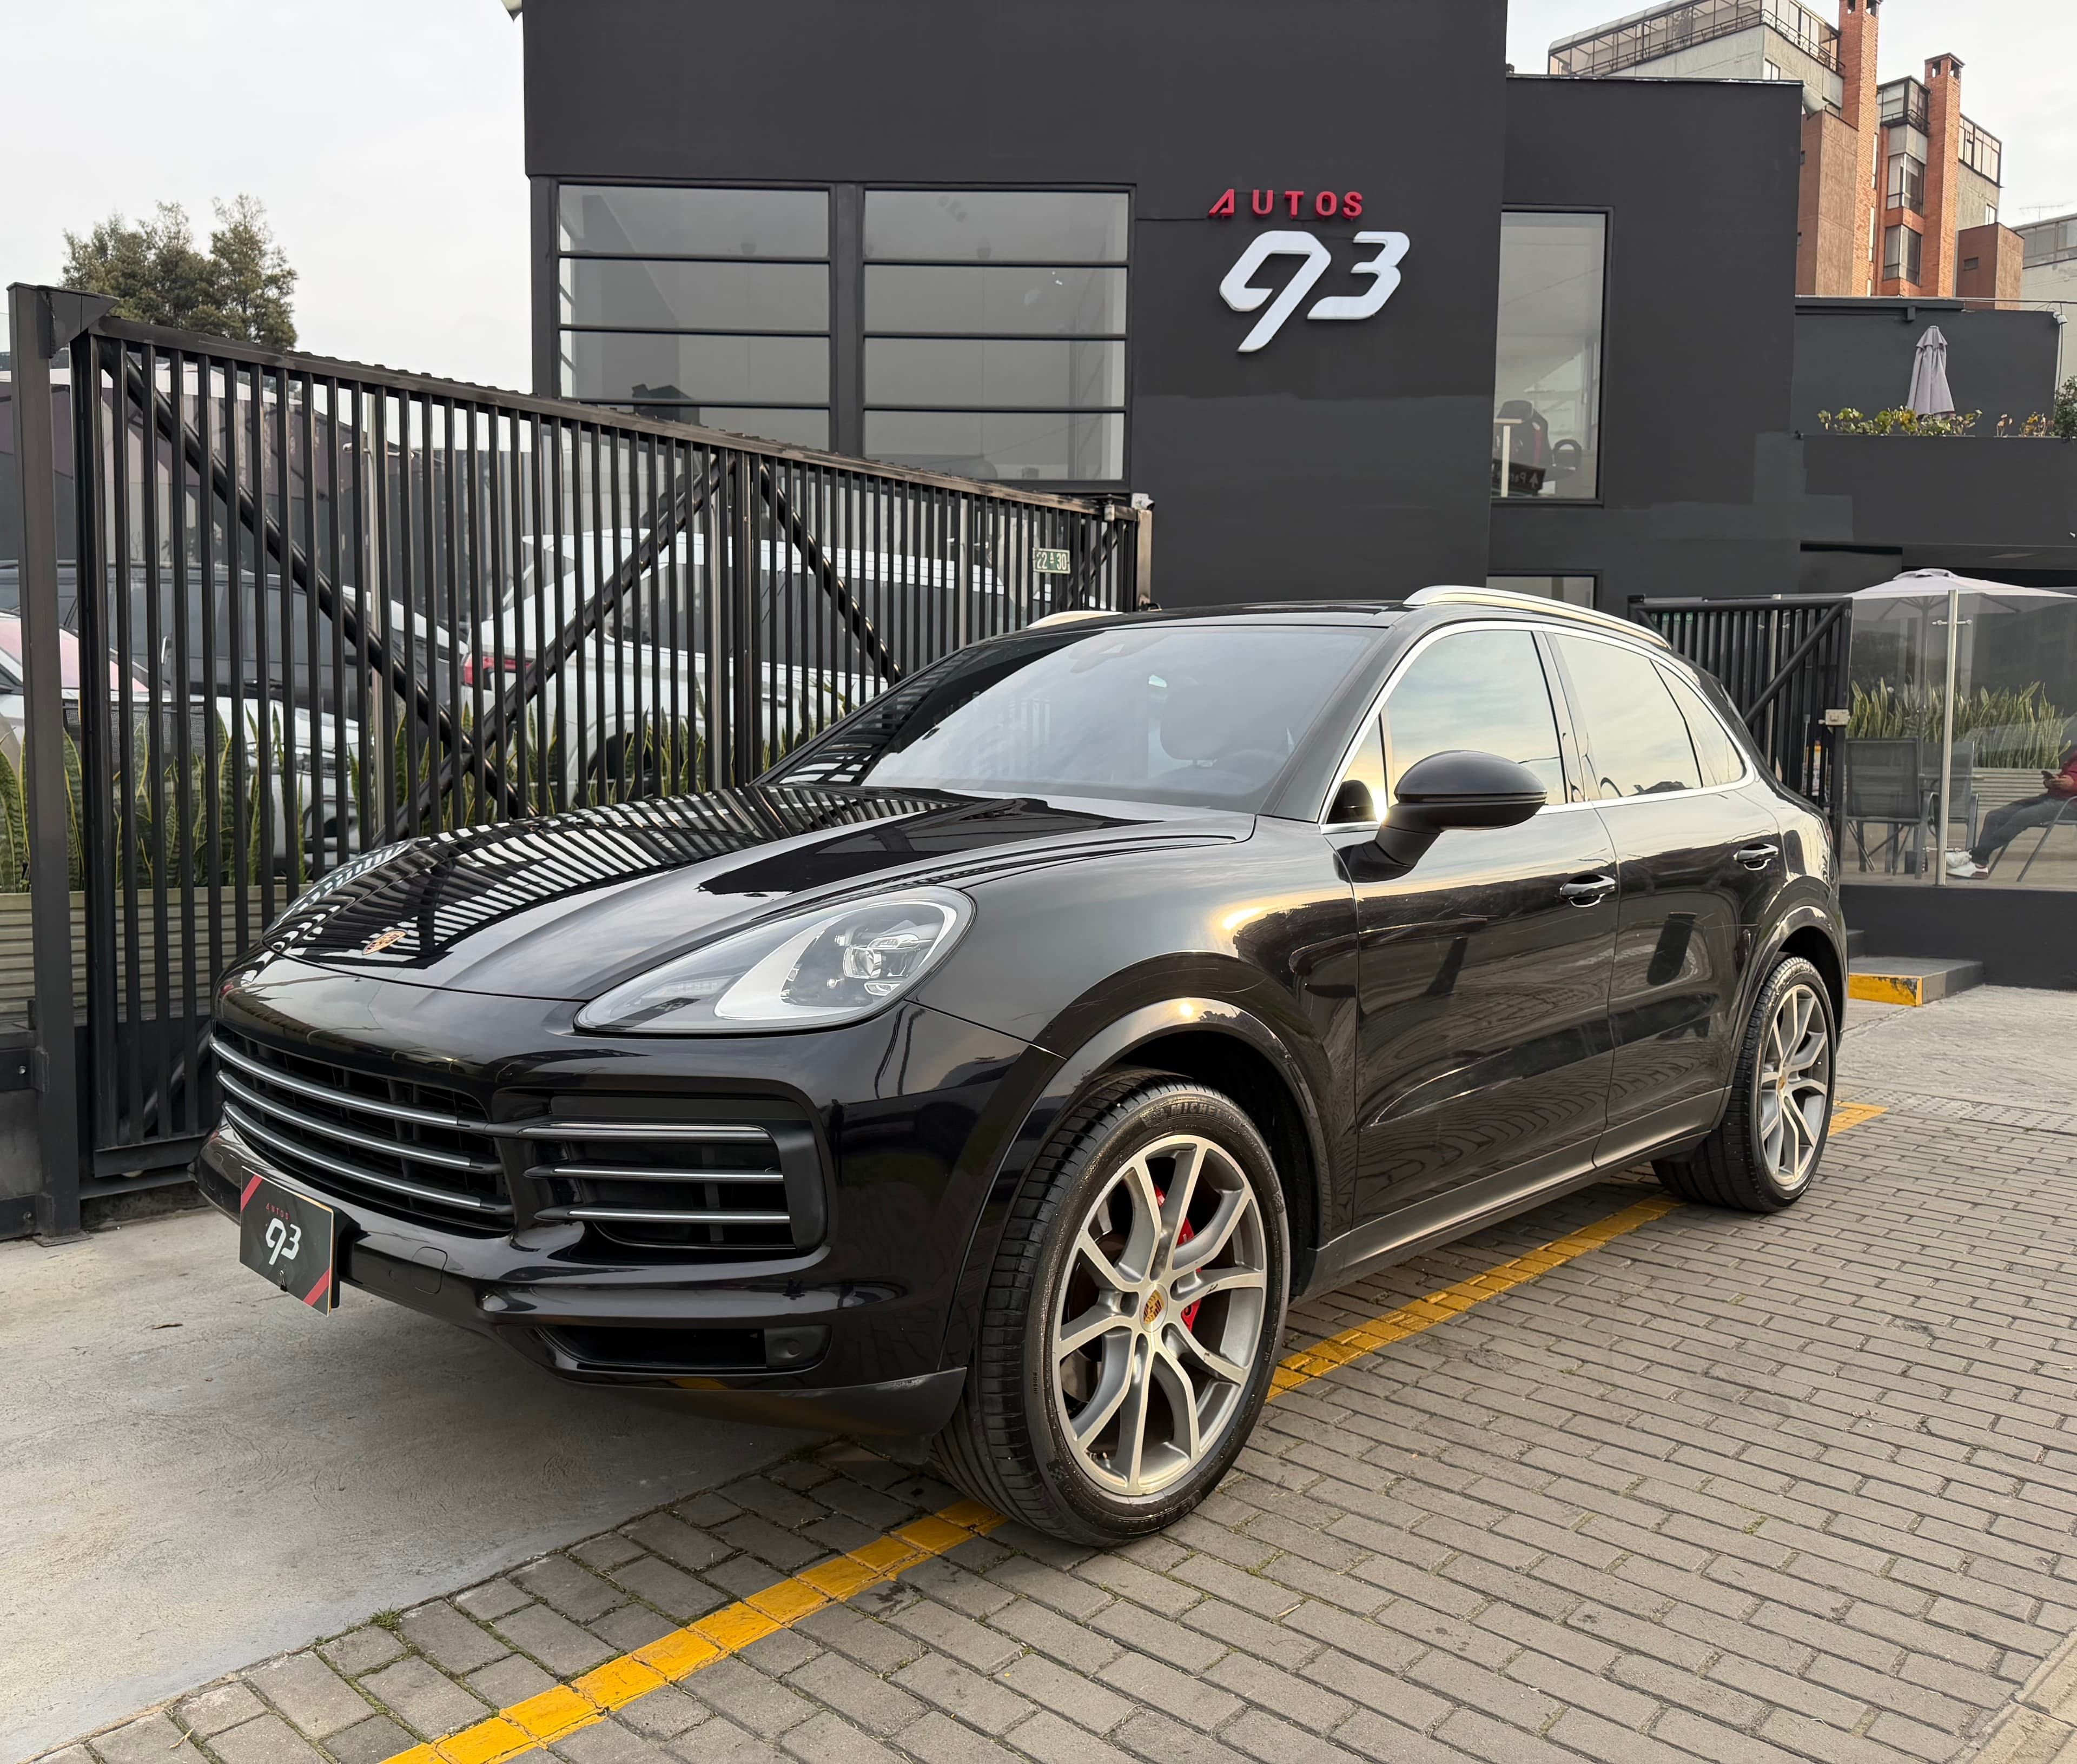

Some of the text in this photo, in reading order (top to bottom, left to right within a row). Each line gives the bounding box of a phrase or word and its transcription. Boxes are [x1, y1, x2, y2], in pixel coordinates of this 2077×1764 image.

[1208, 189, 1363, 220] AUTOS
[1219, 230, 1411, 353] 93
[266, 1203, 289, 1221] AUTOS
[266, 1218, 301, 1265] 93
